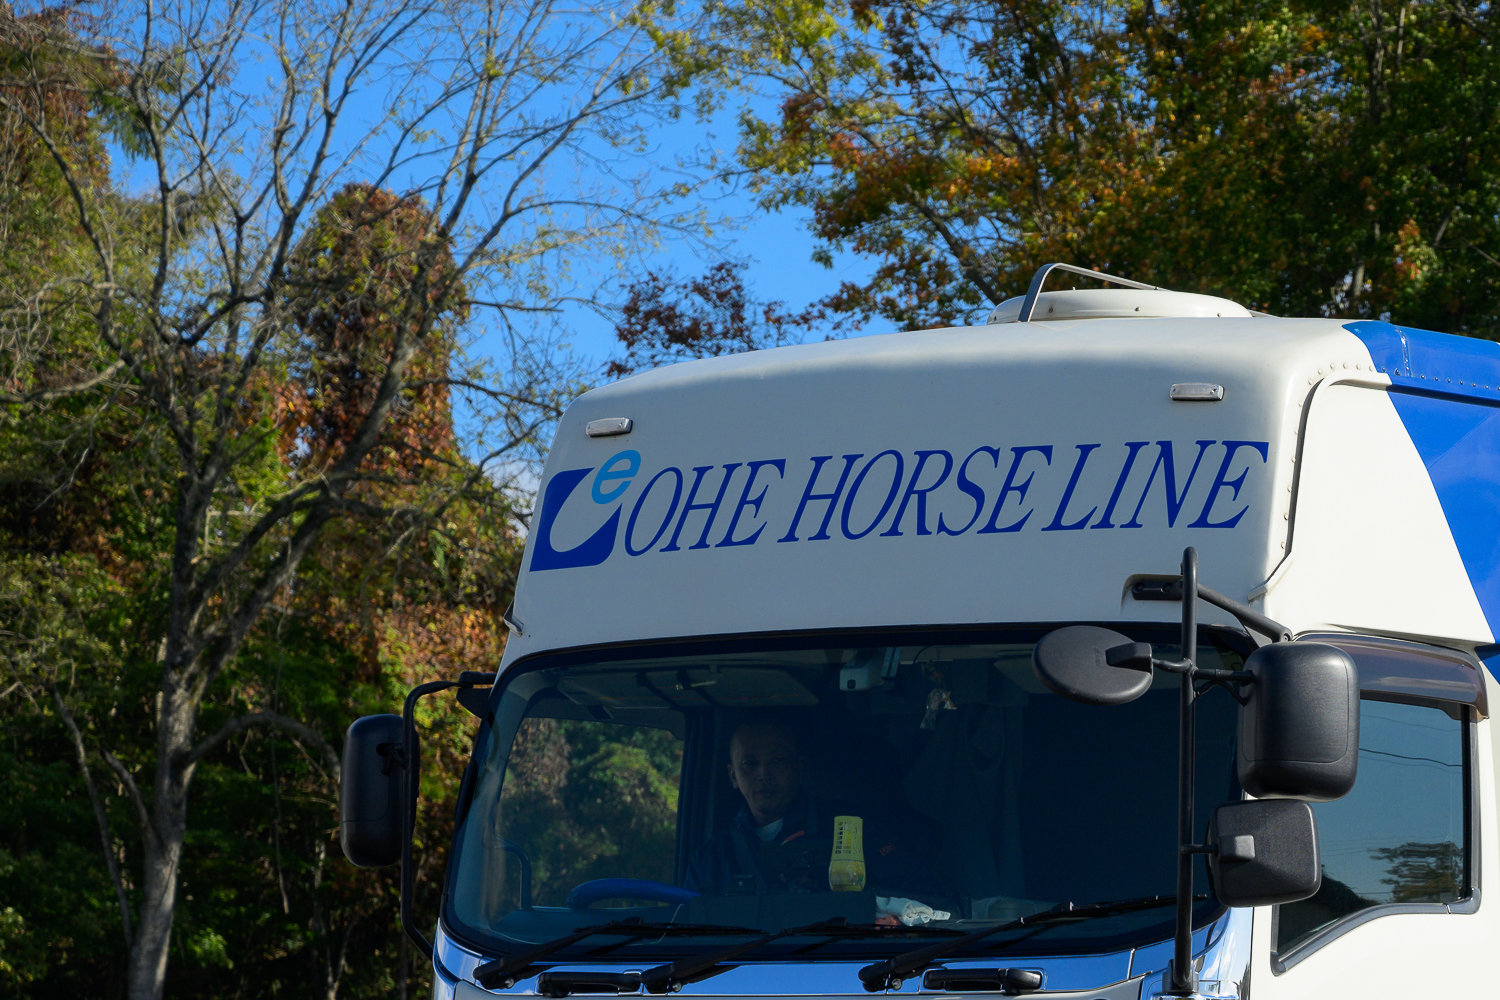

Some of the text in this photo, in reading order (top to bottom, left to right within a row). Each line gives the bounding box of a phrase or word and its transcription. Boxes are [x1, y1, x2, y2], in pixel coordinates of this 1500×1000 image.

[624, 440, 1269, 557] OHE HORSE LINE
